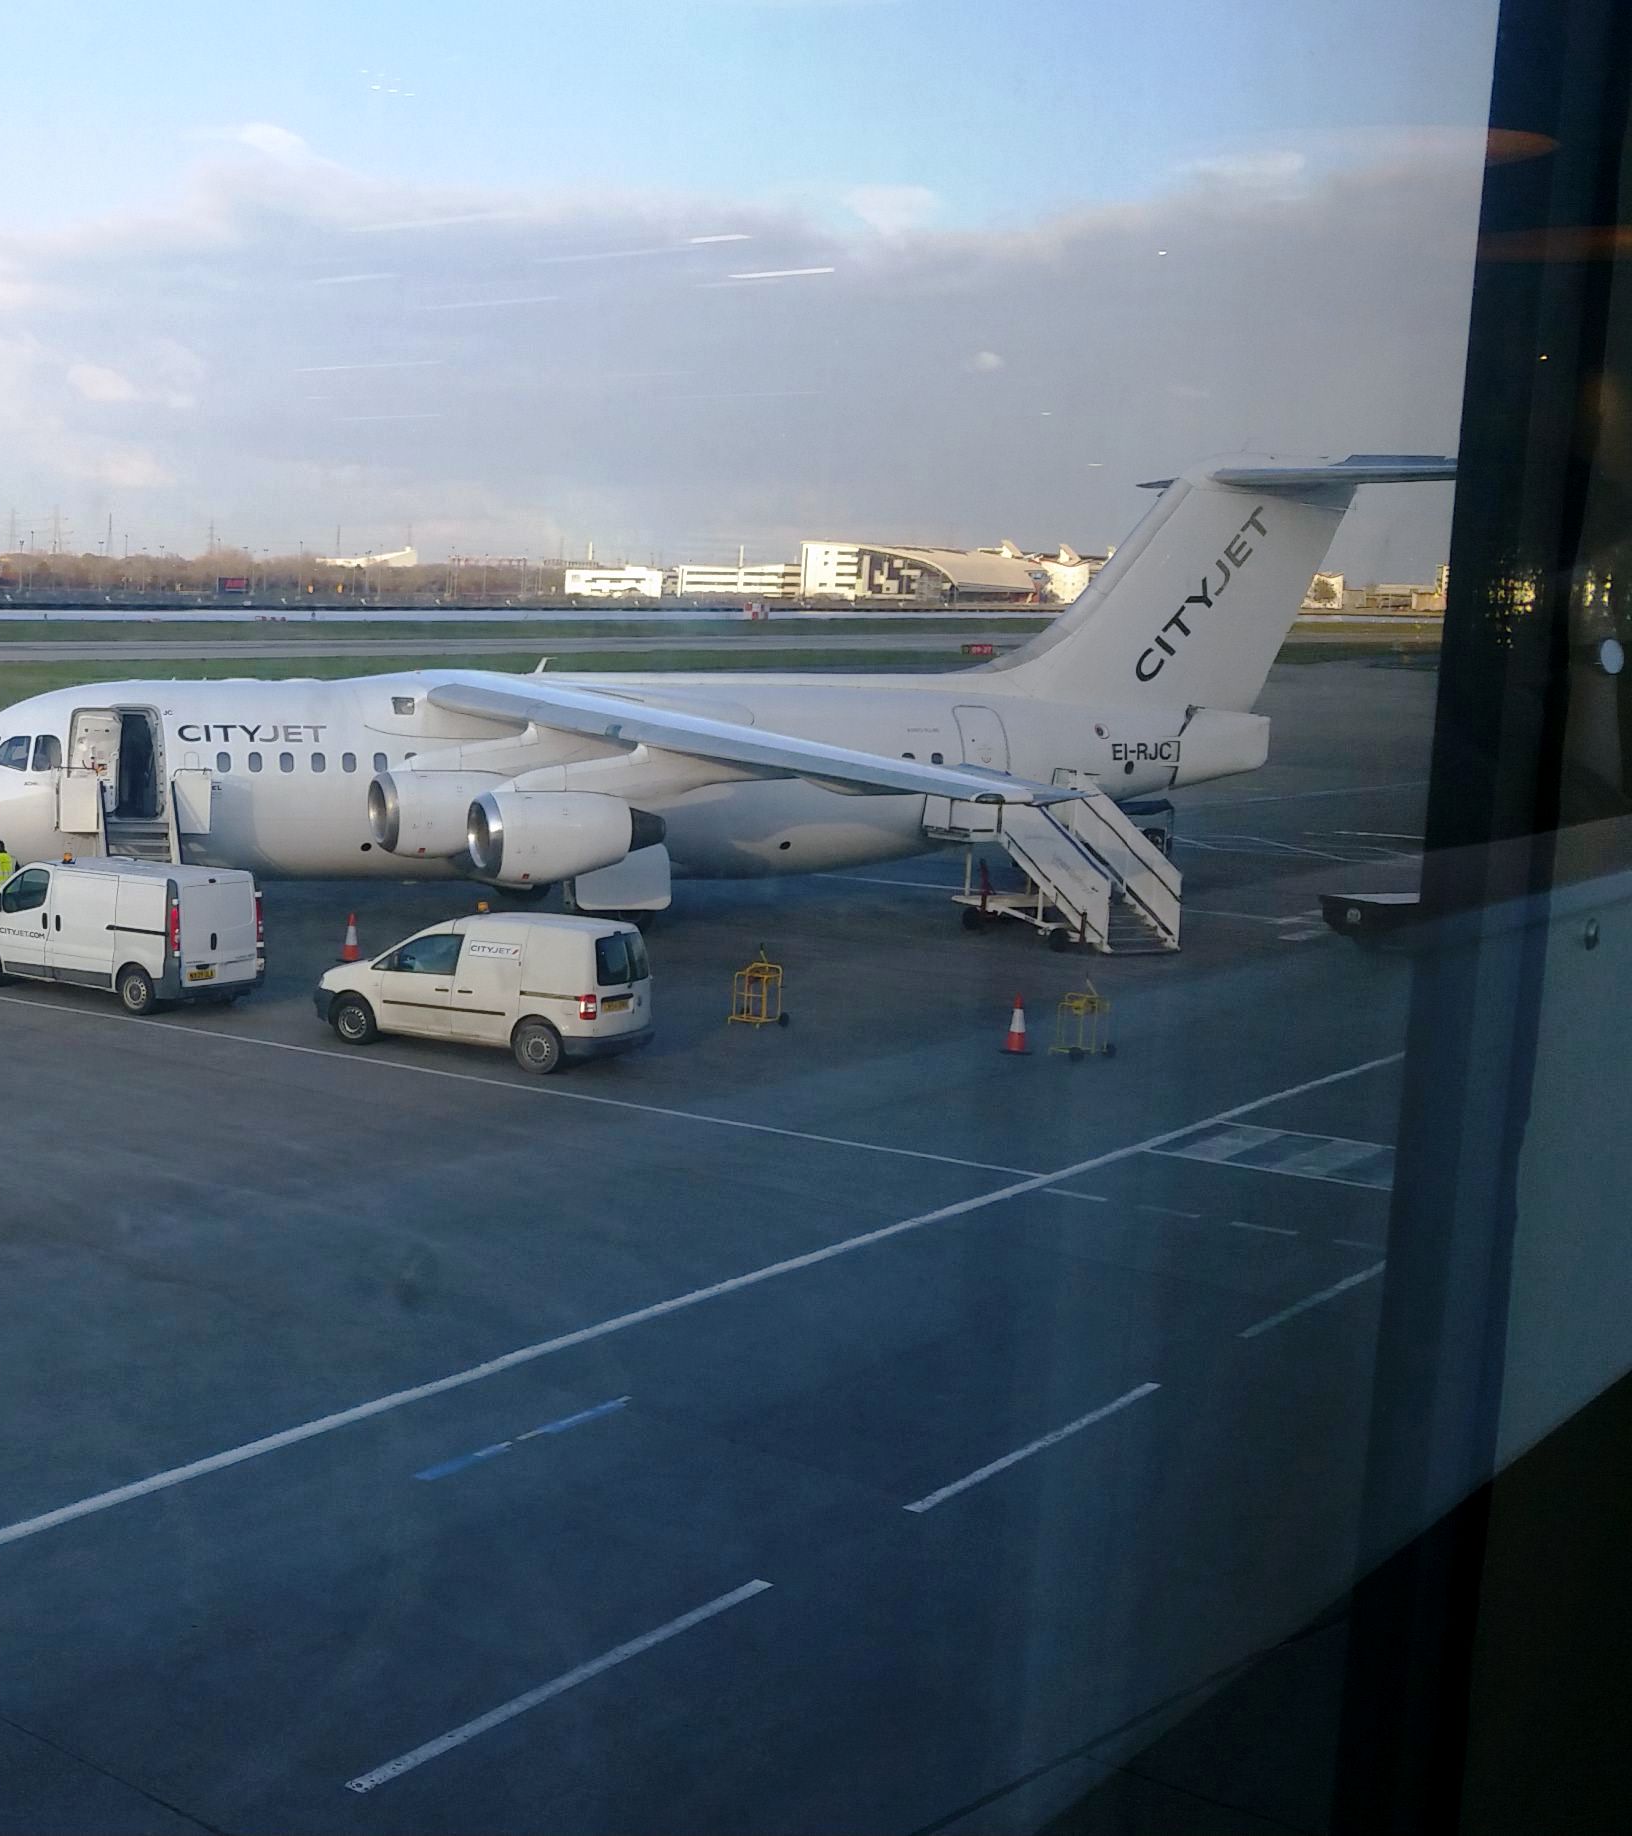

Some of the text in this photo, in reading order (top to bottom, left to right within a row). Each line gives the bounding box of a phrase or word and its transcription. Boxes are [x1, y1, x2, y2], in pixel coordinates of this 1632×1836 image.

[1135, 506, 1267, 682] CITYJET
[178, 725, 327, 742] CITYJET
[1112, 743, 1172, 761] EI-RJC
[470, 945, 512, 955] CITYJET
